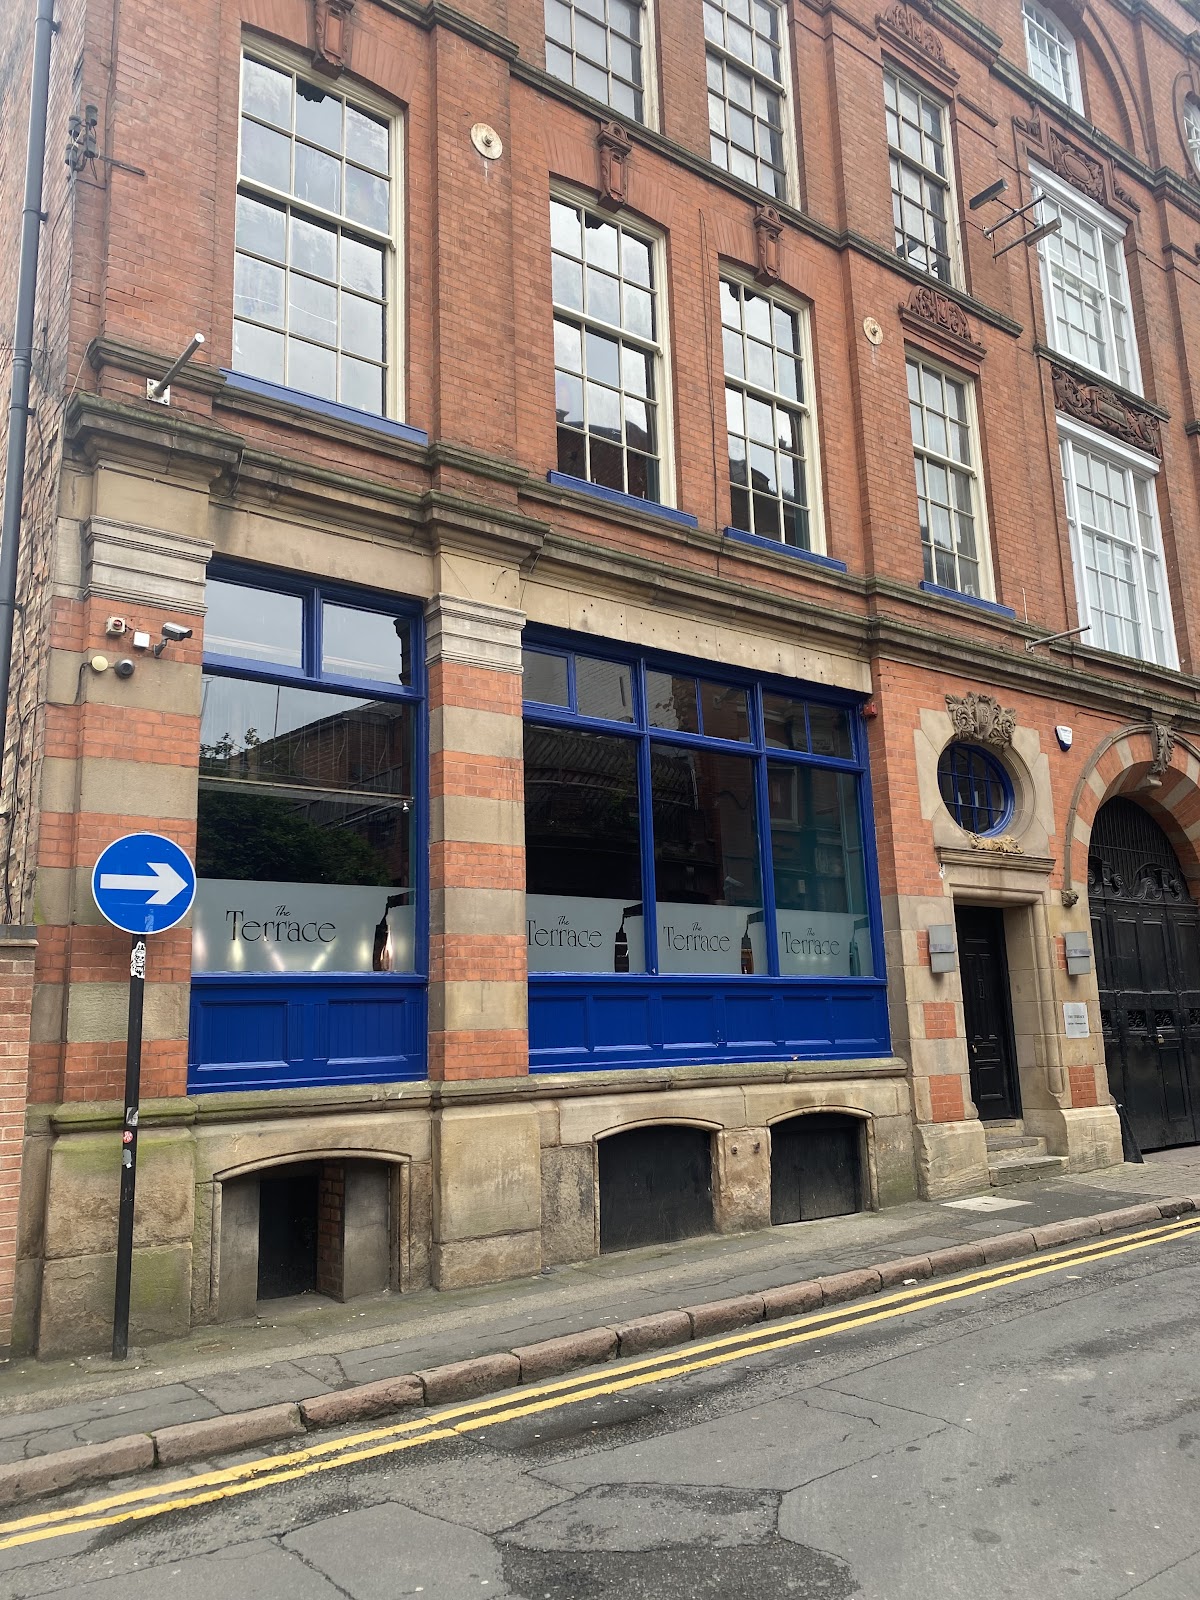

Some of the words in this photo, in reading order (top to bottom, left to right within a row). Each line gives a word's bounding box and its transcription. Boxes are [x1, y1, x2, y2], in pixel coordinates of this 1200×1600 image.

[275, 905, 291, 916] The
[226, 910, 337, 942] Terrace
[557, 915, 570, 926] The
[692, 921, 703, 931] The
[526, 919, 602, 948] Terrace
[663, 926, 731, 952] Terrace
[806, 927, 817, 936] The
[781, 931, 840, 956] Terrace
